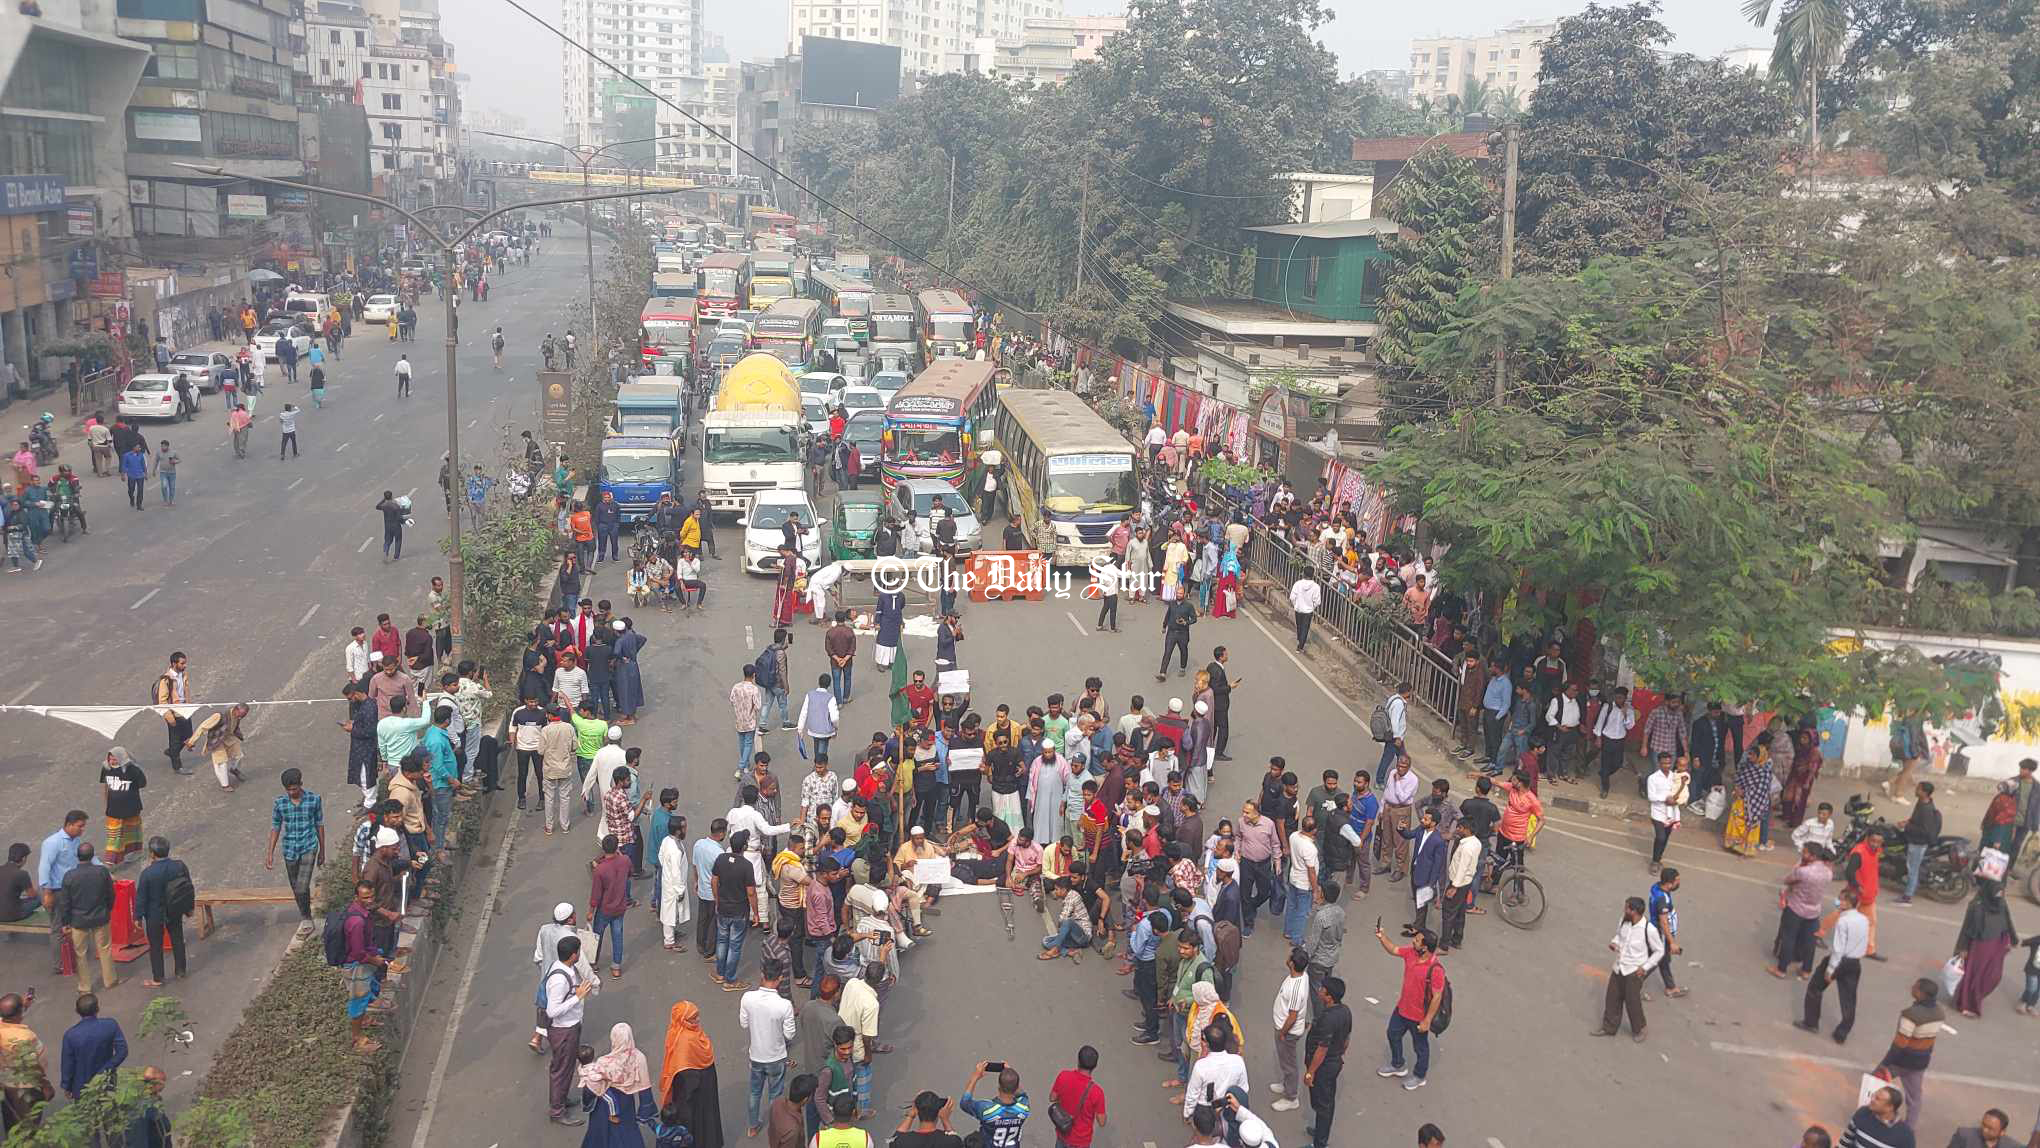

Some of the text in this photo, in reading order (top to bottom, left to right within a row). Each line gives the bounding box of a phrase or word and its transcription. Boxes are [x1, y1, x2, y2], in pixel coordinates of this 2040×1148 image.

[18, 180, 63, 207] Bank Asia
[871, 314, 914, 322] SHYAMOLI
